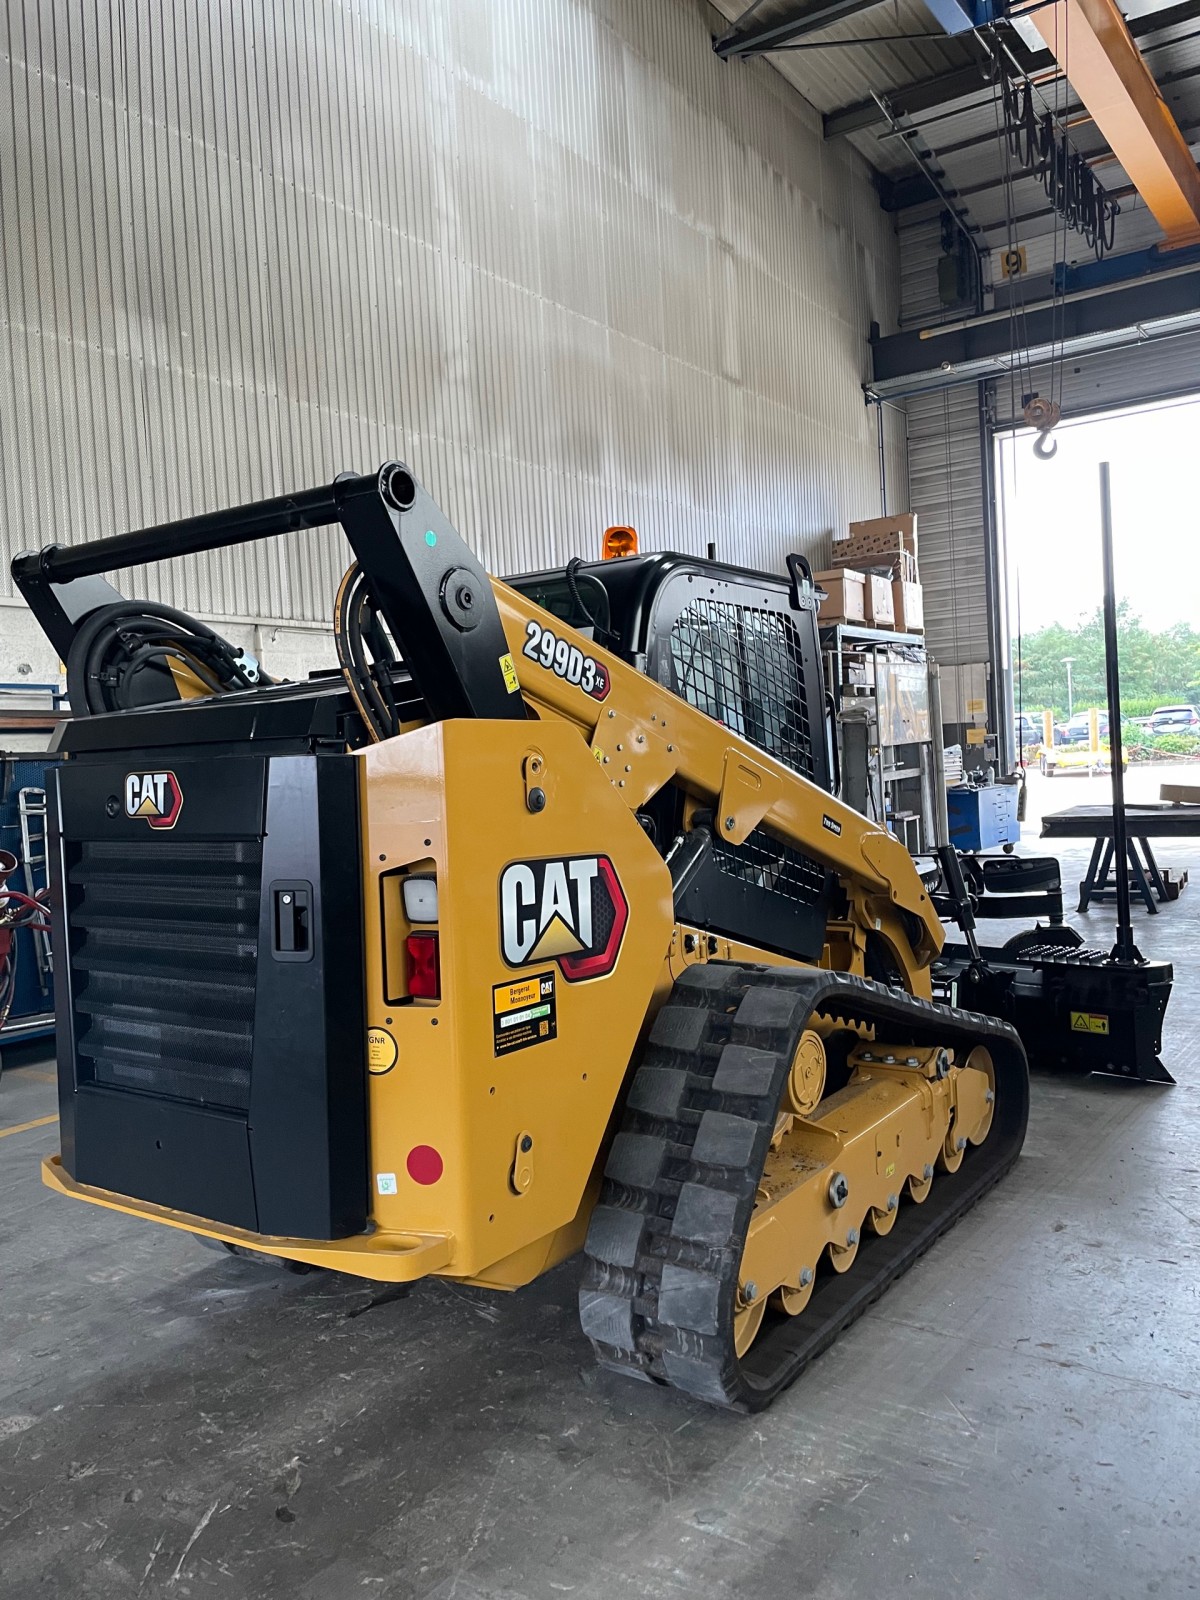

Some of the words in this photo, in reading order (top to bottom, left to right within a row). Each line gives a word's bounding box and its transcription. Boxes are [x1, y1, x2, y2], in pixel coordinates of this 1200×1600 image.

[1006, 251, 1022, 275] 9
[523, 621, 596, 692] 299D3
[595, 675, 605, 690] XE
[126, 774, 168, 815] CAT
[501, 858, 598, 964] CAT
[509, 985, 530, 996] Bergerat
[540, 981, 553, 995] CAT
[368, 1036, 386, 1045] GNR
